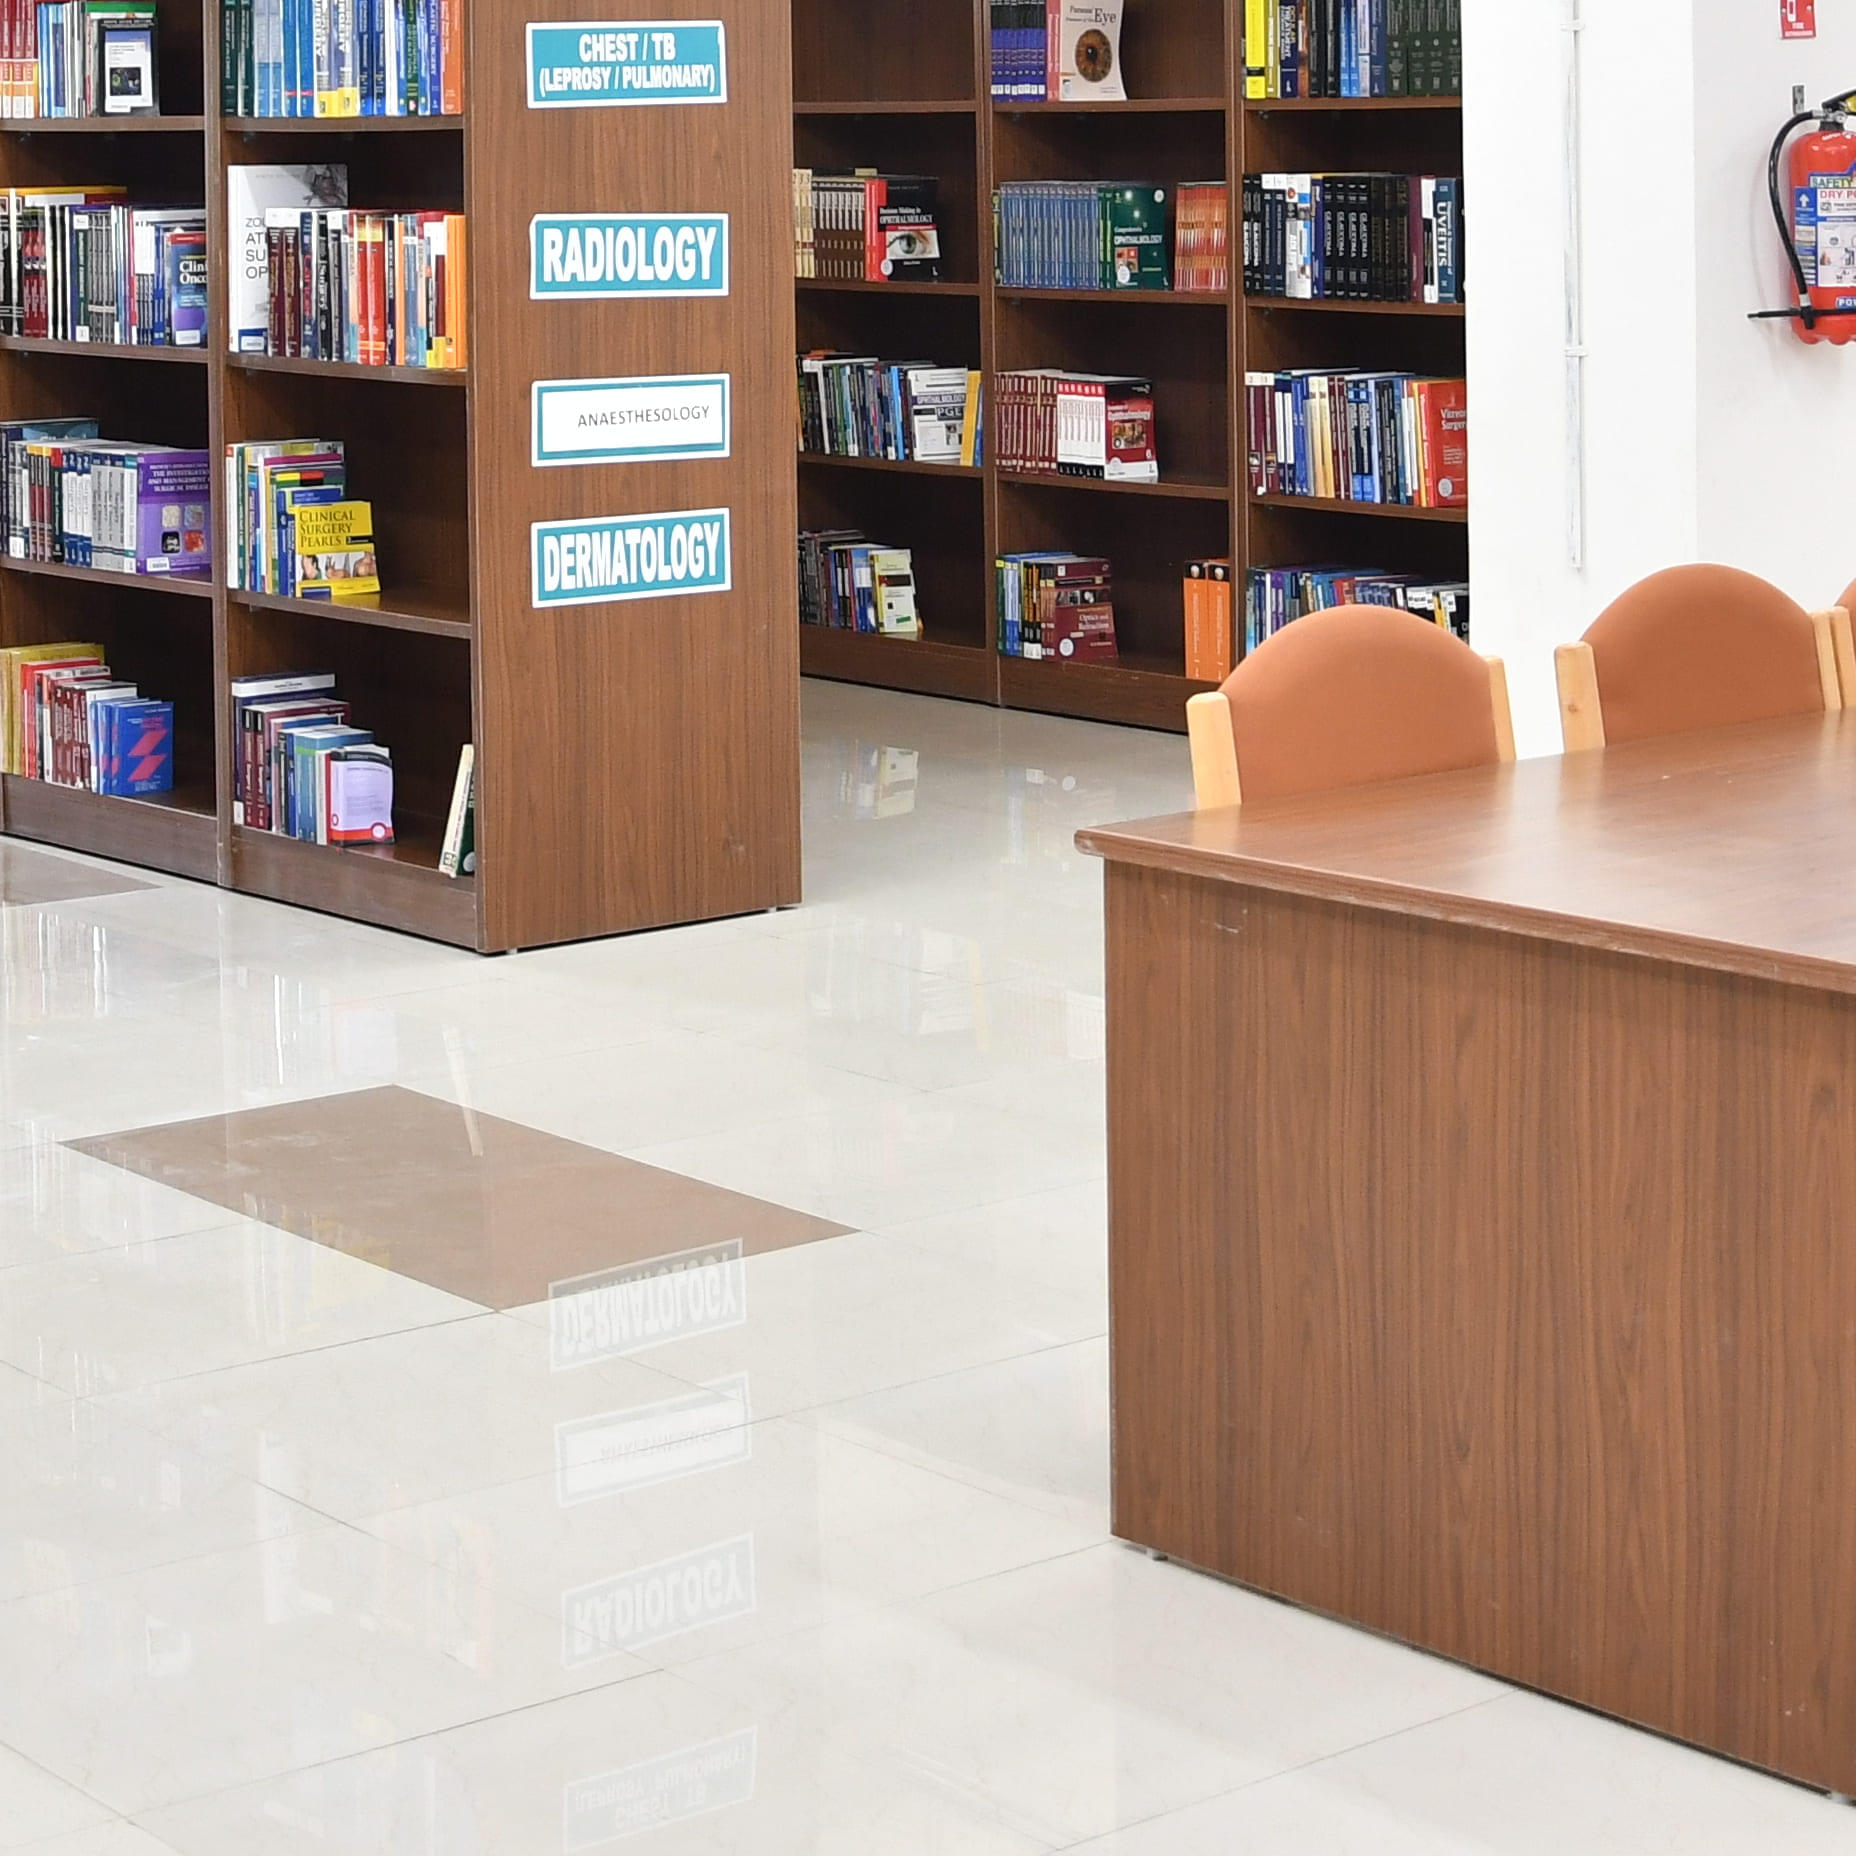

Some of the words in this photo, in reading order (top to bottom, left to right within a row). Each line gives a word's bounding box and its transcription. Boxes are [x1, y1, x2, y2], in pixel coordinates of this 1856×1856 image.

[1094, 8, 1117, 26] Eye
[579, 33, 638, 63] CHEST
[642, 33, 648, 62] /
[651, 32, 676, 61] TB
[539, 67, 612, 98] (LEPROSY
[614, 67, 620, 90] /
[622, 64, 715, 93] PULMONARY)
[1811, 177, 1852, 188] SAFETY
[1820, 190, 1843, 199] DRY
[1437, 202, 1447, 267] UVEITIS
[543, 226, 717, 282] RADIOLOGY
[577, 405, 710, 428] ANAESTHESOLOGY
[299, 509, 356, 523] CLINICAL
[300, 523, 353, 535] SURGERY
[300, 535, 342, 548] PEARLS
[544, 522, 721, 592] DERMATOLOGY
